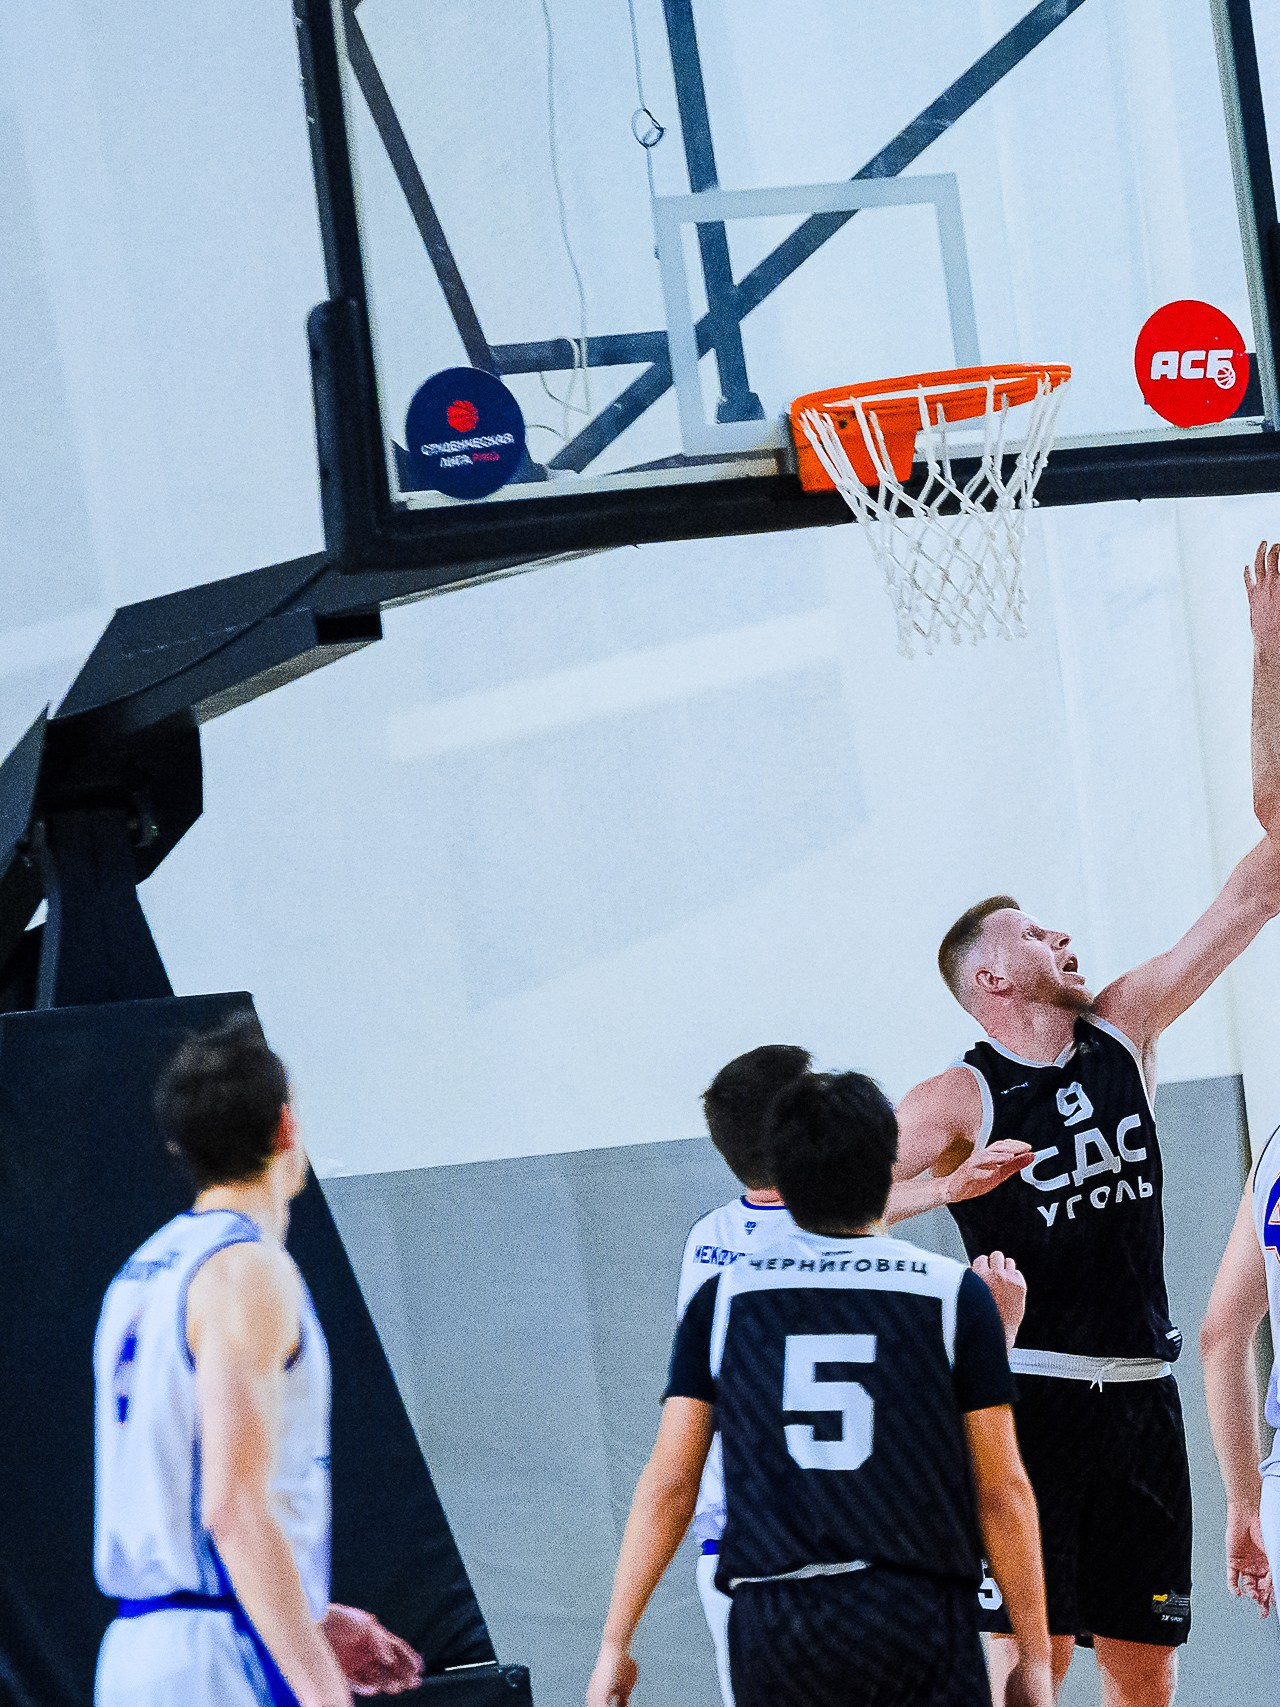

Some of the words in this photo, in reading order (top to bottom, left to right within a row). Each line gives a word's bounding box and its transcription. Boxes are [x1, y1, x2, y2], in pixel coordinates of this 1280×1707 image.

[1151, 350, 1236, 389] АСБ
[1056, 1081, 1094, 1127] 9
[1020, 1113, 1148, 1192] СДС
[1037, 1176, 1154, 1227] УГОЛЬ
[750, 1257, 929, 1275] ЧЕРНИГОВЕЦ
[782, 1333, 877, 1471] 5
